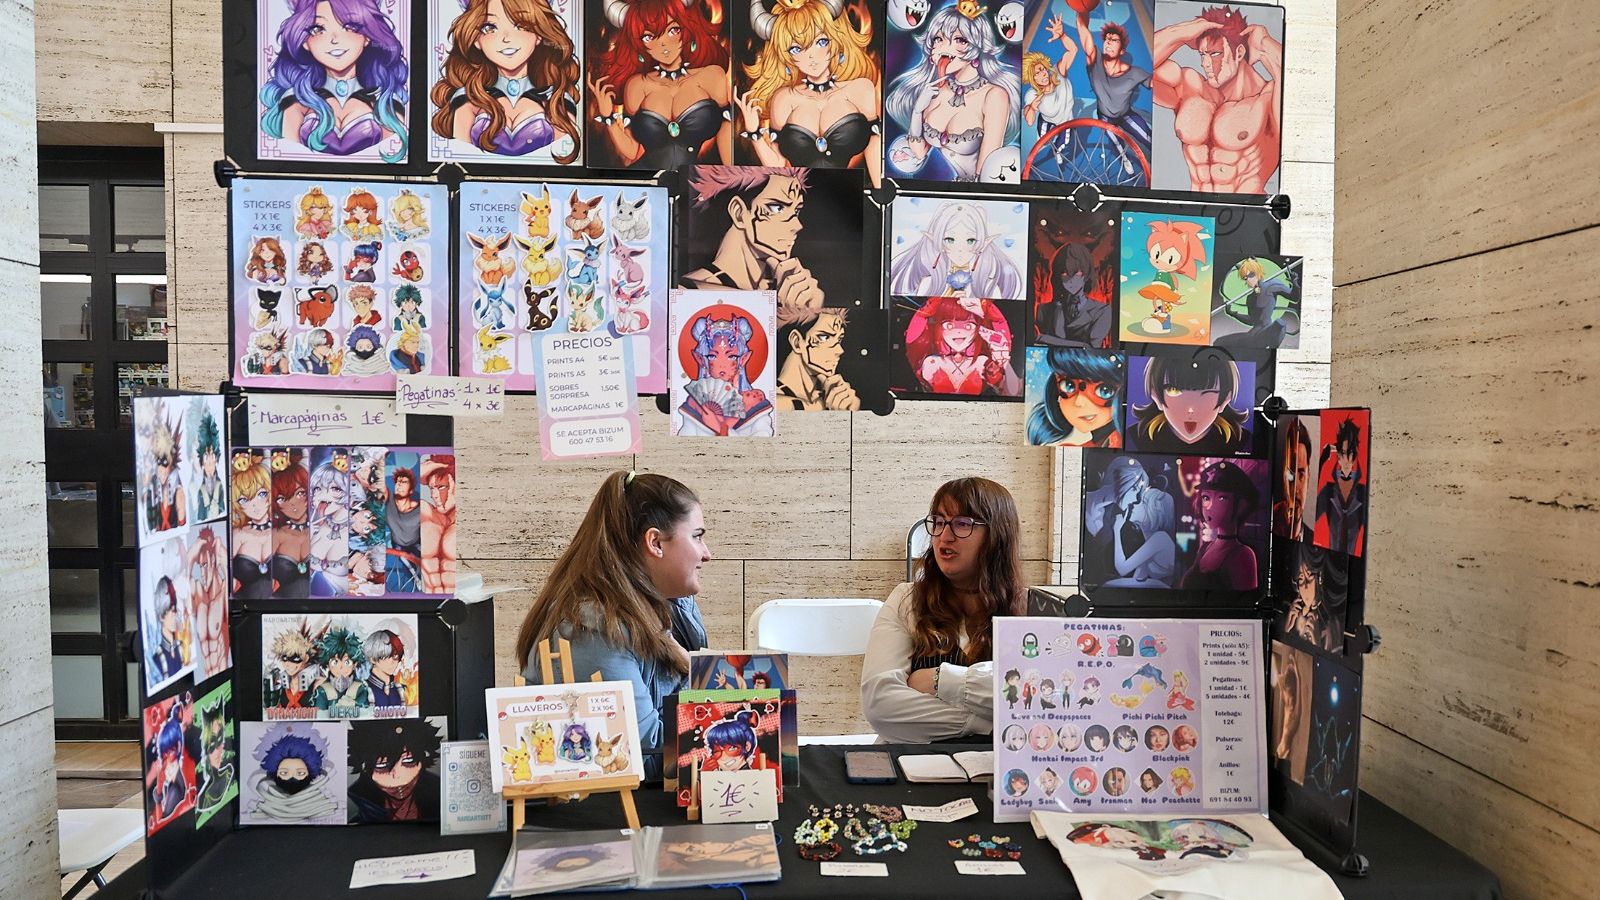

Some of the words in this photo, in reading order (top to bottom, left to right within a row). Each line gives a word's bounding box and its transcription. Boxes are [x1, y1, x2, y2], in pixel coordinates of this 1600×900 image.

[243, 200, 292, 209] STICKERS
[469, 203, 517, 212] STICKERS
[255, 212, 258, 220] 1
[270, 212, 281, 220] 1€
[480, 215, 484, 223] 1
[486, 215, 492, 223] X
[494, 215, 505, 223] 1€
[252, 223, 259, 231] 4
[261, 223, 268, 231] X
[270, 223, 283, 231] 3€
[478, 226, 484, 234] 4
[486, 226, 493, 234] X
[495, 226, 508, 234] 3€
[553, 337, 613, 351] PRECIOS
[547, 358, 574, 366] PRINTS
[598, 354, 608, 362] 5€
[548, 371, 575, 379] PRINTS
[599, 368, 609, 376] 3€
[549, 384, 580, 392] SOBRES
[402, 384, 457, 408] Pegatinas
[464, 383, 474, 394] 1
[486, 383, 501, 394] 1€
[550, 391, 590, 400] SORPRESA
[463, 399, 472, 410] 4
[486, 400, 501, 411] 3€
[551, 401, 611, 413] MARCAPÁGINAS
[260, 409, 348, 432] Marcapáginas
[361, 411, 386, 425] 1€
[567, 428, 597, 437] ACEPTA
[598, 426, 624, 435] BIZUM
[585, 437, 594, 445] 47
[1064, 623, 1126, 631] PEGATINAS:
[1077, 660, 1116, 668] R.E.P.O.
[328, 705, 360, 719] DEKU
[373, 705, 408, 718] SHOTO
[512, 703, 563, 713] LLAVEROS
[460, 749, 486, 759] SÍGUEME
[1060, 755, 1088, 763] Impact
[1152, 755, 1190, 763] Blackpink
[720, 783, 746, 807] 1€
[1001, 798, 1033, 807] Ladybug
[1073, 797, 1092, 806] Amy
